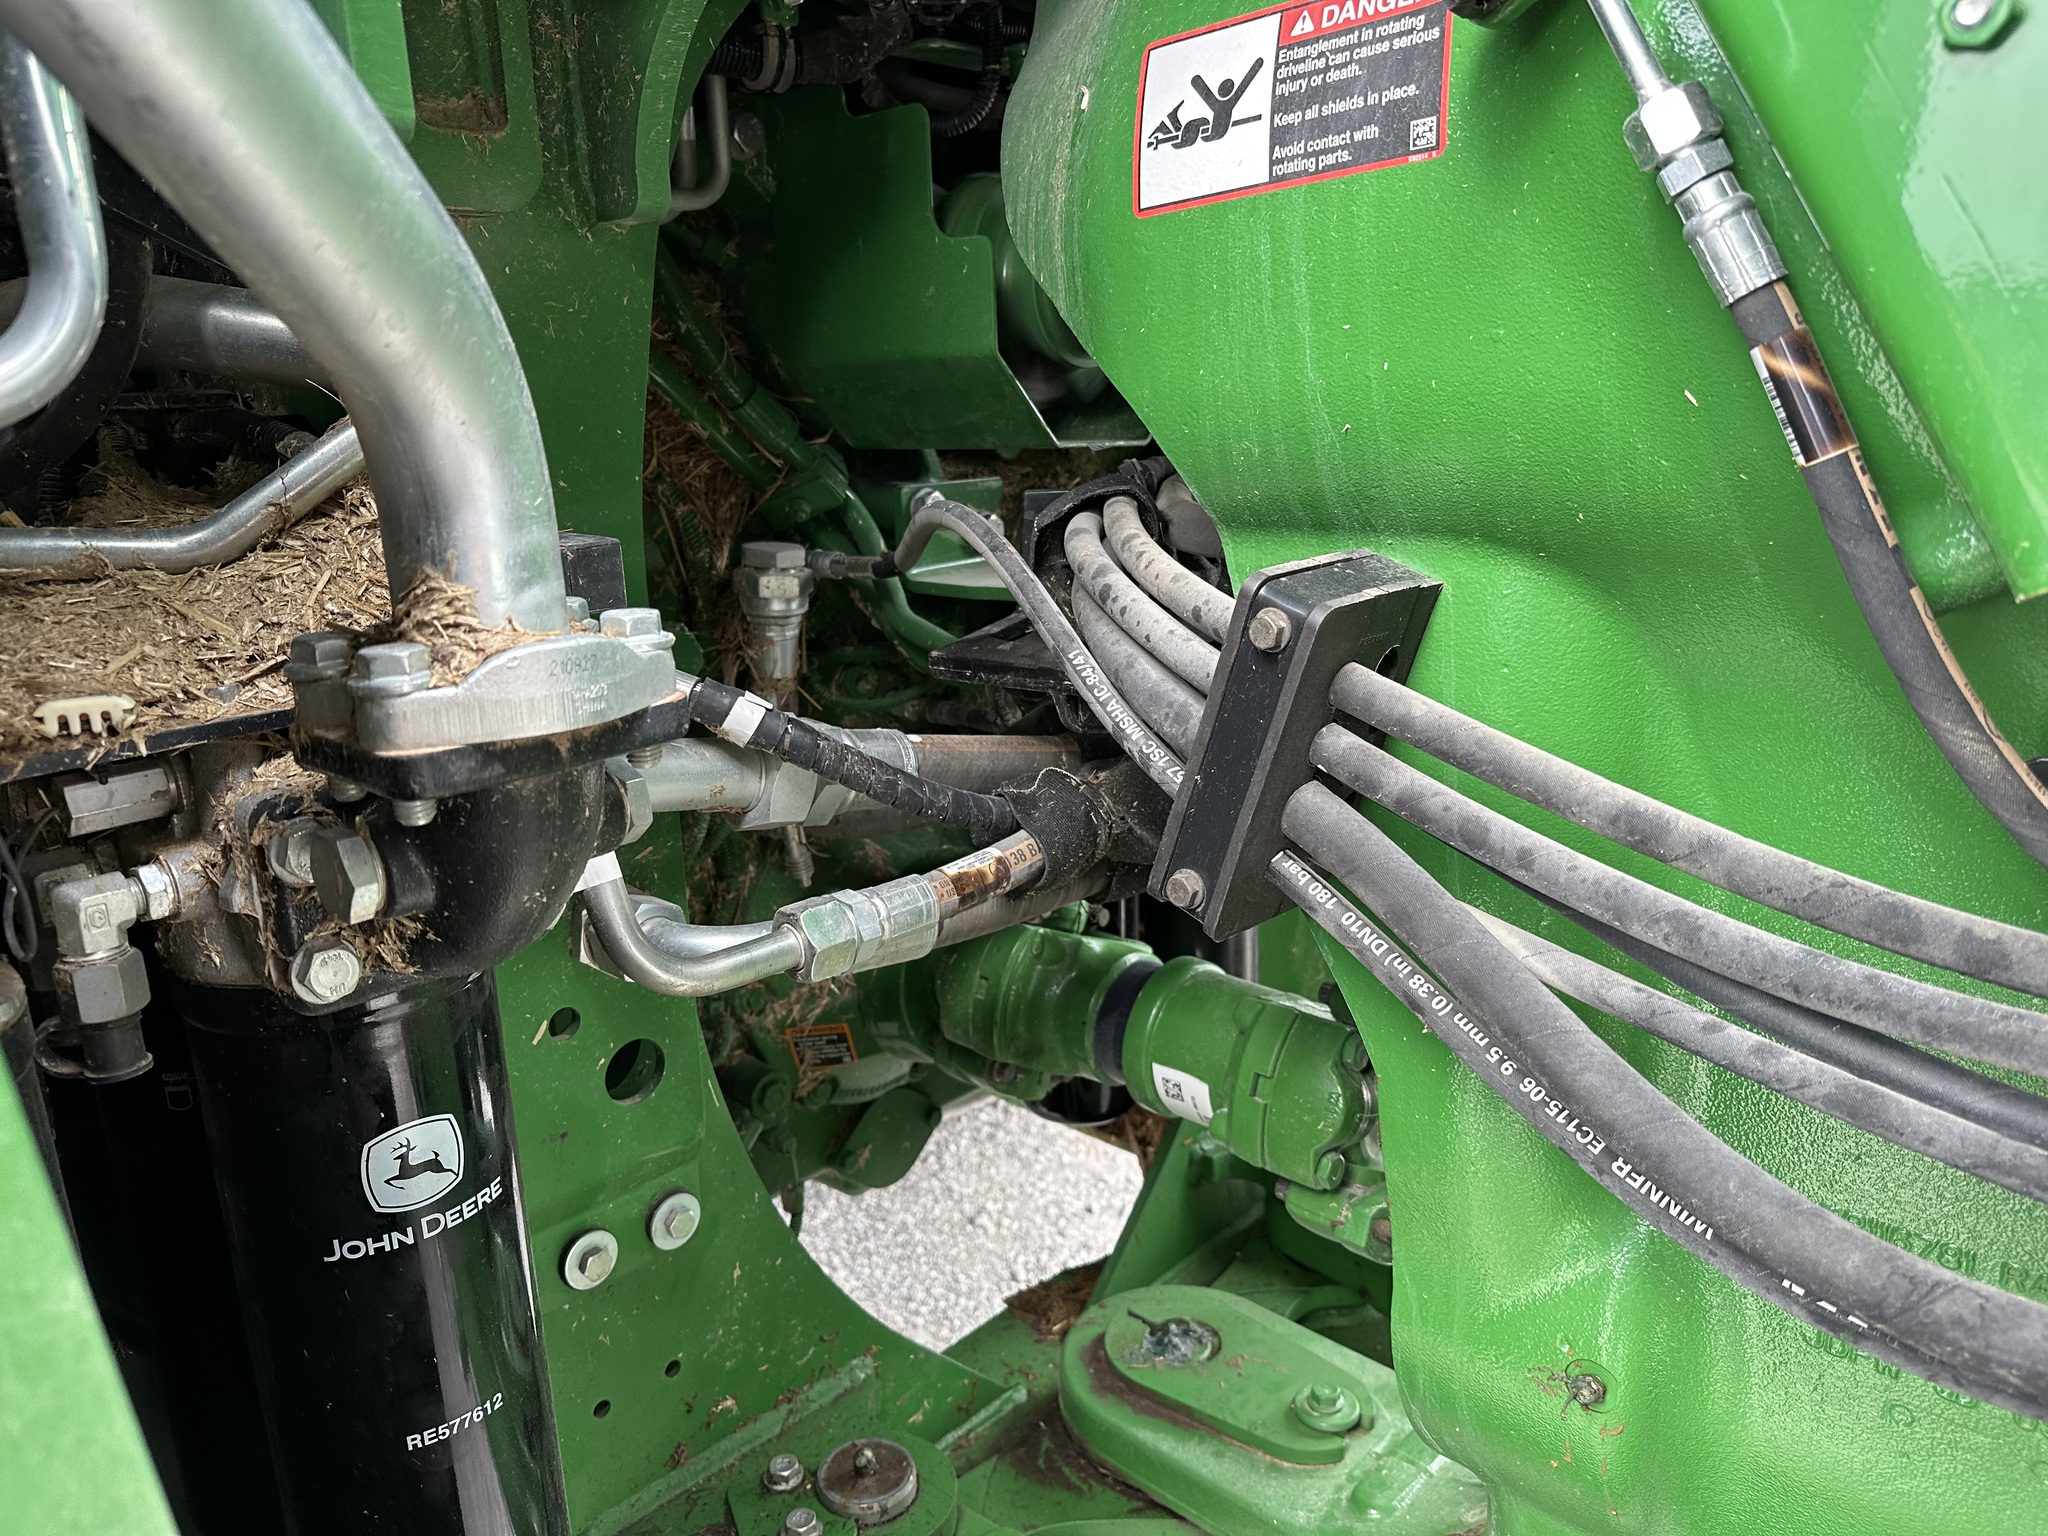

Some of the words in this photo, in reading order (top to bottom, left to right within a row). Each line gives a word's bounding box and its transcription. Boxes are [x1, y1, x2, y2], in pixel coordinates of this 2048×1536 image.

[1321, 0, 1423, 29] DANG
[1276, 57, 1326, 79] driveline
[1329, 51, 1350, 66] can
[1353, 41, 1390, 60] cause
[1392, 28, 1440, 49] serious
[1278, 32, 1359, 64] Entanglement
[1361, 28, 1373, 41] in
[1375, 15, 1426, 38] rotating
[1275, 78, 1308, 96] injury
[1310, 73, 1324, 86] or
[1326, 64, 1363, 83] death.
[1273, 111, 1303, 128] Keep
[1305, 104, 1319, 120] all
[1321, 95, 1365, 116] shields
[1367, 91, 1379, 106] in
[1382, 84, 1420, 106] place.
[1272, 140, 1305, 160] Avoid
[1307, 131, 1351, 152] contact
[1353, 124, 1379, 143] with
[1272, 155, 1317, 176] rotating
[1318, 149, 1352, 167] parts.
[1067, 649, 1112, 702] IC-84/41
[1106, 698, 1145, 741] MSHA
[1142, 740, 1170, 768] 1SC
[1281, 858, 1312, 884] bar
[1307, 880, 1339, 910] 180
[1340, 911, 1390, 957] DN10
[1383, 951, 1413, 978] in)
[1408, 974, 1454, 1017] (0.38
[1453, 1012, 1490, 1046] mm
[1485, 1046, 1518, 1076] 9.5
[1518, 1076, 1607, 1156] EC115-06
[323, 1225, 415, 1262] JOHN
[420, 1175, 504, 1241] DEERE
[405, 1391, 504, 1451] RE577612
